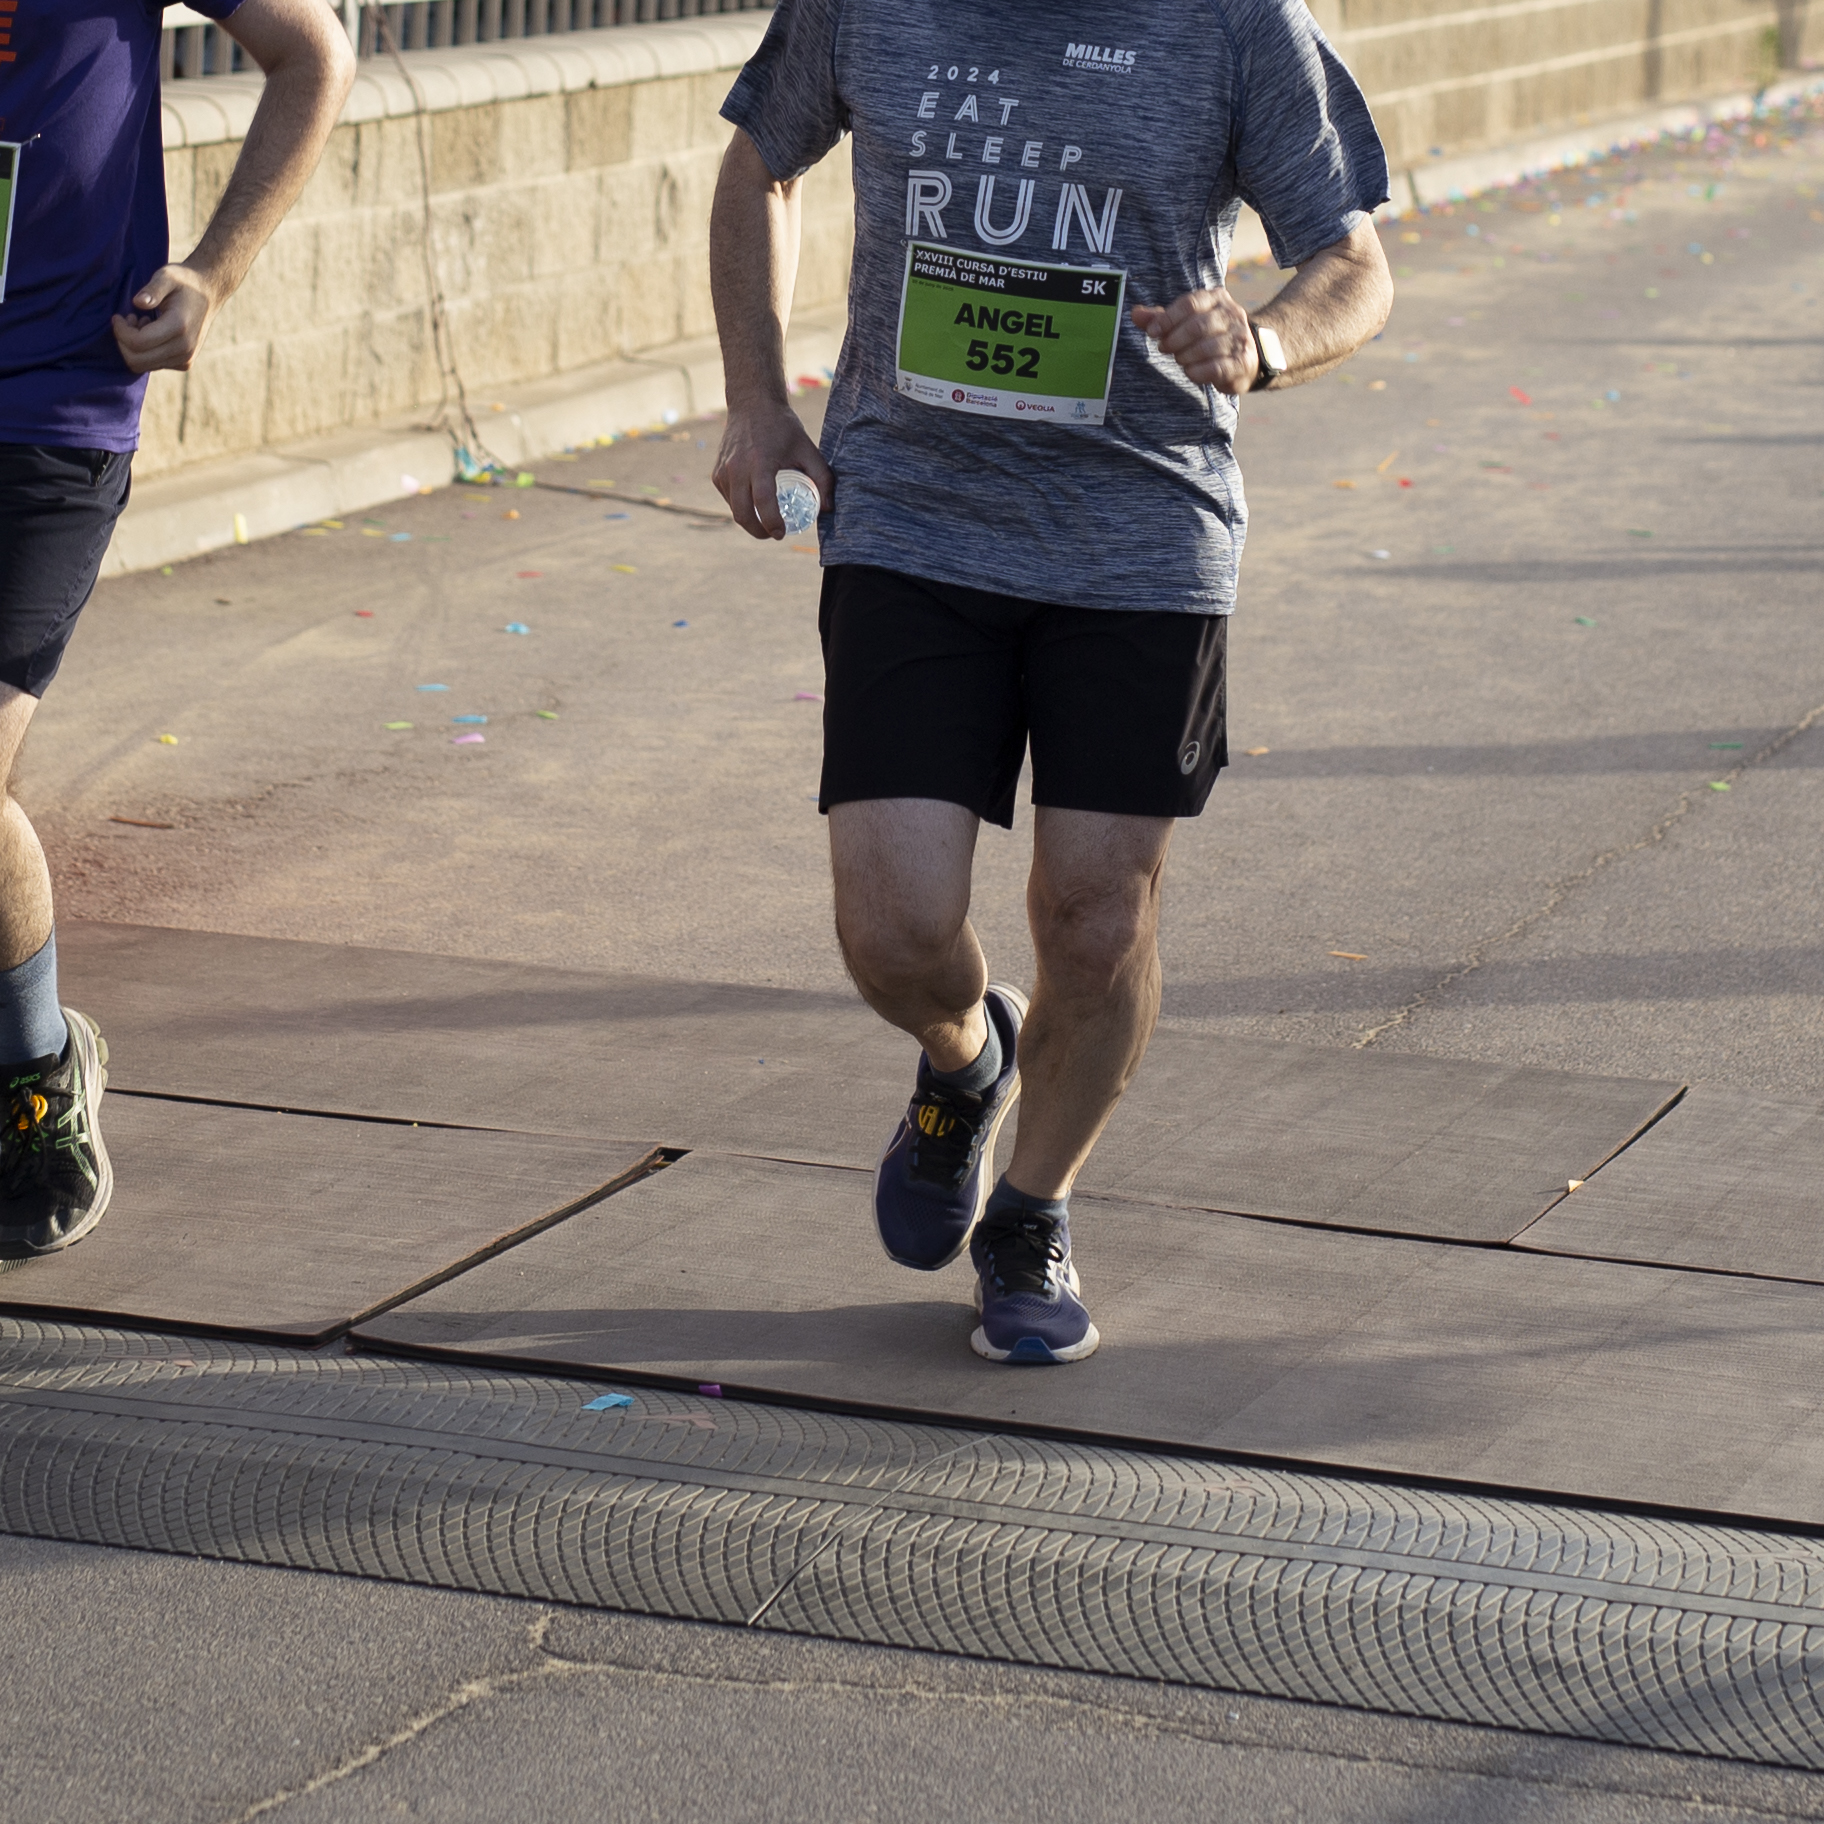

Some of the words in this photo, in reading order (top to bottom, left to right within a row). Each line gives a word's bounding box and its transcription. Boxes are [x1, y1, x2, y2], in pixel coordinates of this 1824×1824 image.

[1062, 58, 1075, 67] DE
[1076, 60, 1132, 75] CERDANYOLA
[1065, 42, 1137, 66] MILLES
[927, 64, 1000, 85] 2024
[917, 91, 1020, 126] EAT
[908, 130, 1083, 171] SLEEP
[905, 169, 1124, 254] RUN
[914, 262, 957, 280] PREMIÀ
[960, 272, 976, 284] DE
[979, 276, 1005, 288] MAR
[915, 249, 954, 266] XXVIII
[956, 258, 995, 274] CURSA
[999, 266, 1048, 282] D'ESTIU
[1081, 279, 1108, 296] 5K
[953, 302, 1061, 340] ANGEL
[965, 339, 1041, 379] 552
[1027, 403, 1055, 413] VEOLIA
